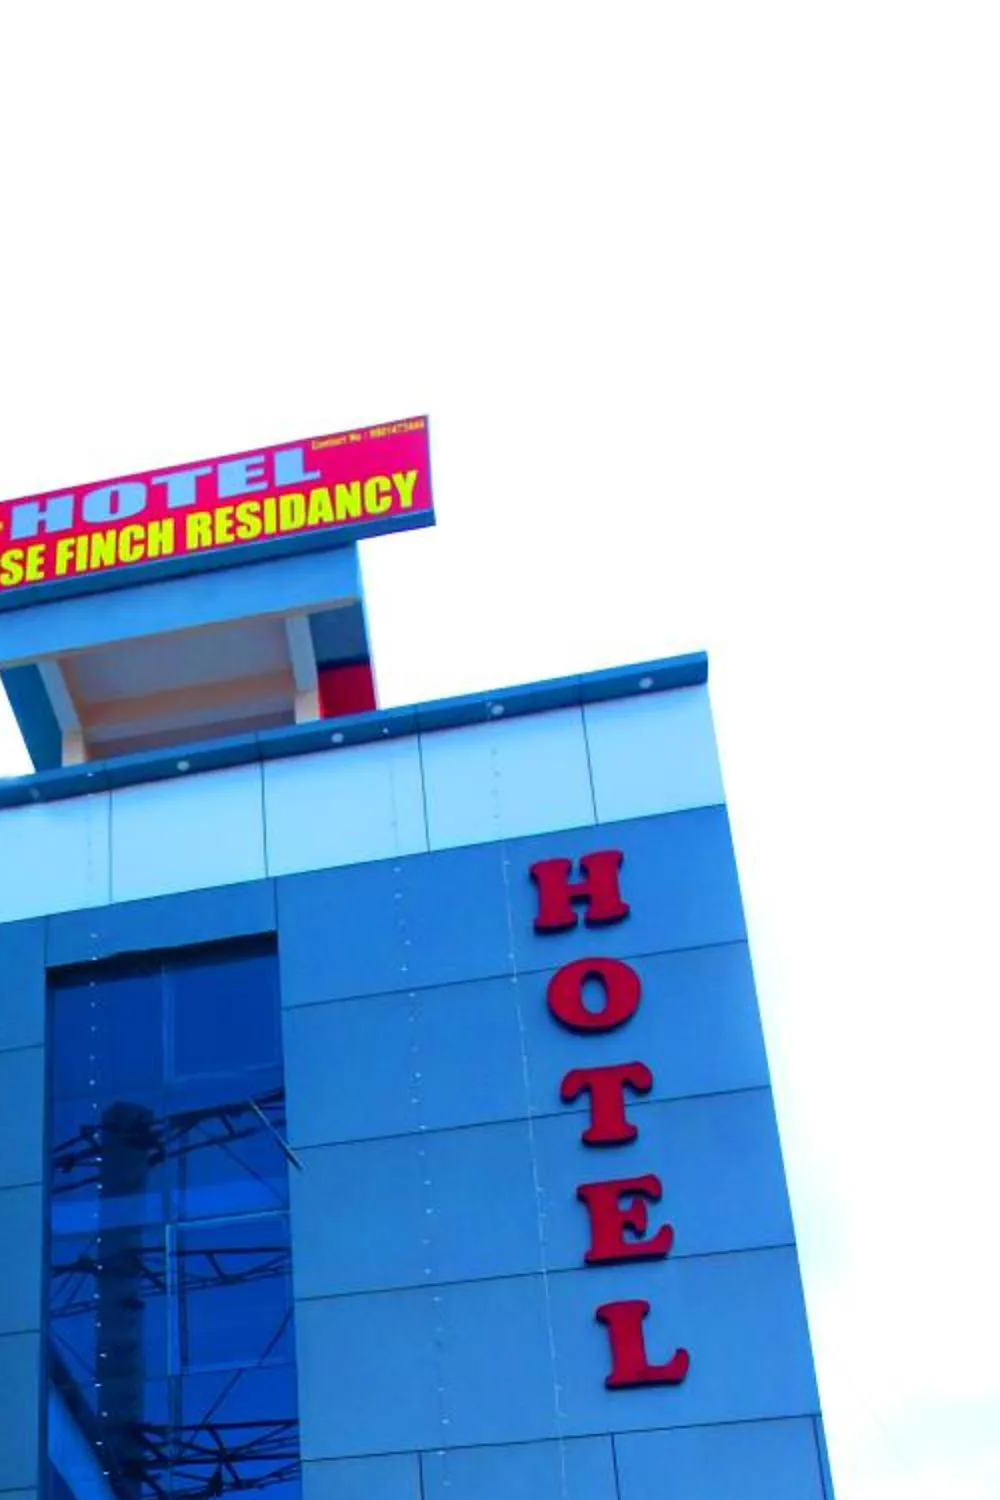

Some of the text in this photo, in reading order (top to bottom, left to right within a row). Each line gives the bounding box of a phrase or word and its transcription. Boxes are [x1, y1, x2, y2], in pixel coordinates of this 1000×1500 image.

[9, 447, 321, 539] HOTEL
[56, 517, 174, 575] FINCH
[186, 470, 419, 548] RESIDANCY
[529, 849, 690, 1391] HOTEL
